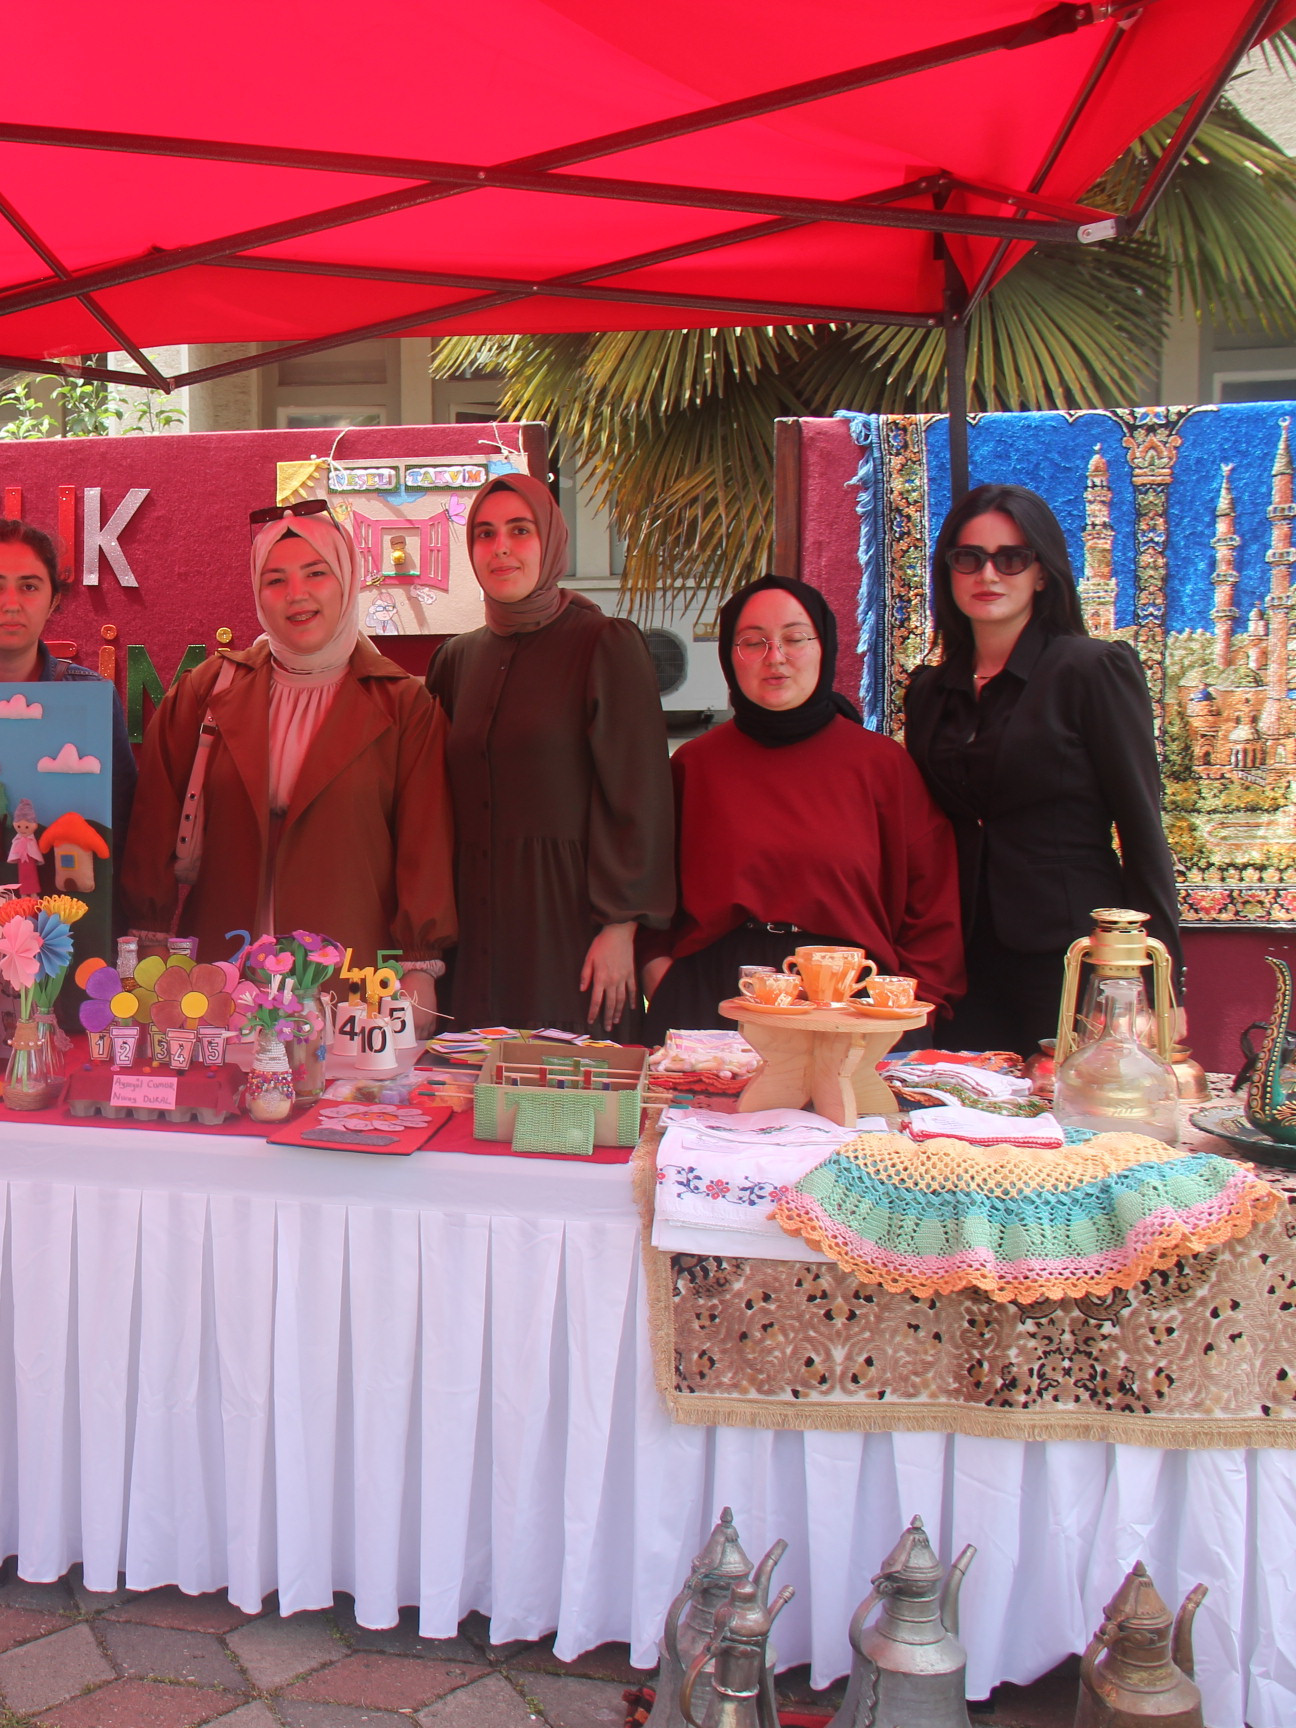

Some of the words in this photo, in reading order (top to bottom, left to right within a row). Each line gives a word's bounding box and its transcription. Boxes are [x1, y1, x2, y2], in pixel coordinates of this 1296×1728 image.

[408, 468, 482, 484] TAKVİM
[338, 1015, 358, 1042] 4
[95, 1037, 104, 1056] 1
[359, 1025, 387, 1054] 10
[118, 1042, 131, 1062] 2
[156, 1041, 168, 1060] 3
[173, 1045, 185, 1064] 4
[207, 1041, 220, 1061] 5
